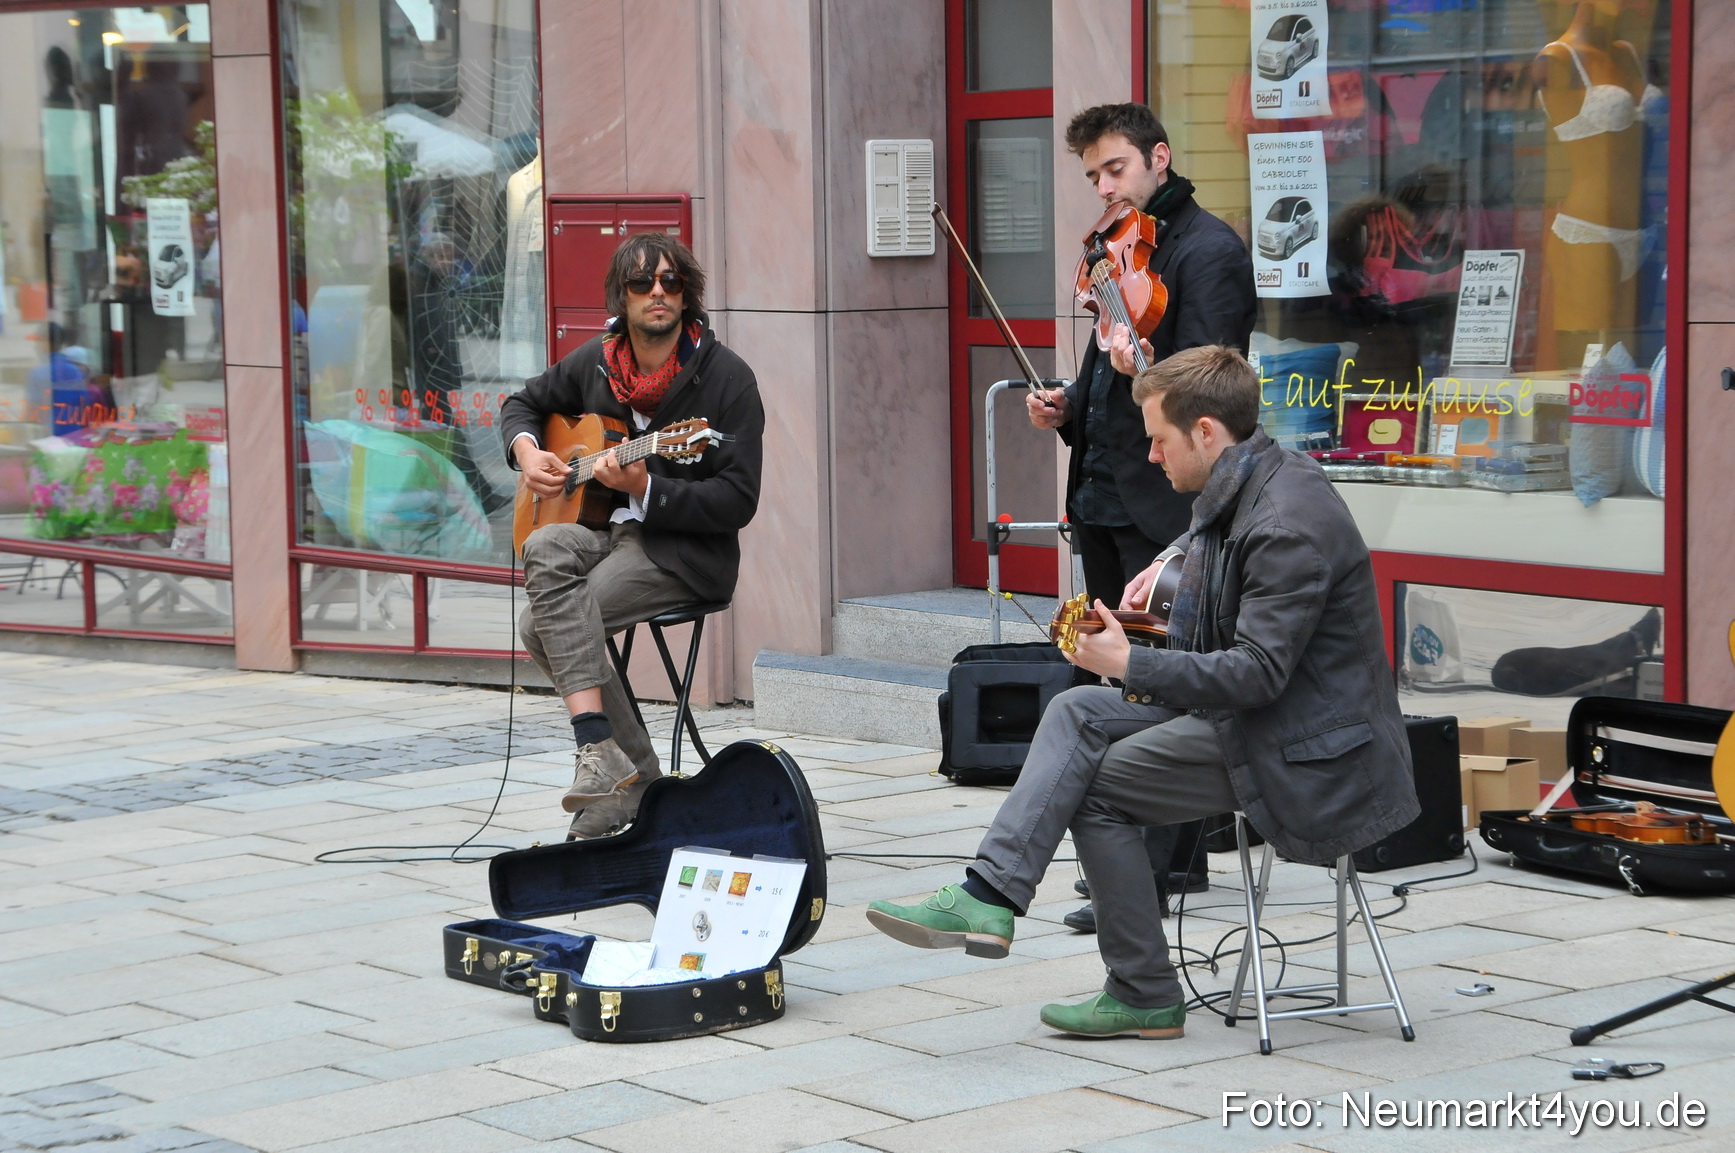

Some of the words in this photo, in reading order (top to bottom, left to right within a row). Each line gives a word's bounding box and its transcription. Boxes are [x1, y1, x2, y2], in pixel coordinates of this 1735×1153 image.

[1256, 93, 1280, 105] Döpfer
[1253, 141, 1298, 152] GEWINNEN
[1299, 140, 1314, 149] SIE
[1257, 154, 1276, 165] einen
[1277, 156, 1297, 164] FIAT
[1297, 155, 1313, 163] 500
[1261, 169, 1309, 179] CABRIOLET
[1465, 260, 1499, 274] Döpfer
[1257, 271, 1280, 284] Döpfer
[1286, 358, 1356, 436] auf
[1361, 365, 1535, 418] zuhause
[1569, 382, 1643, 415] Döpfer
